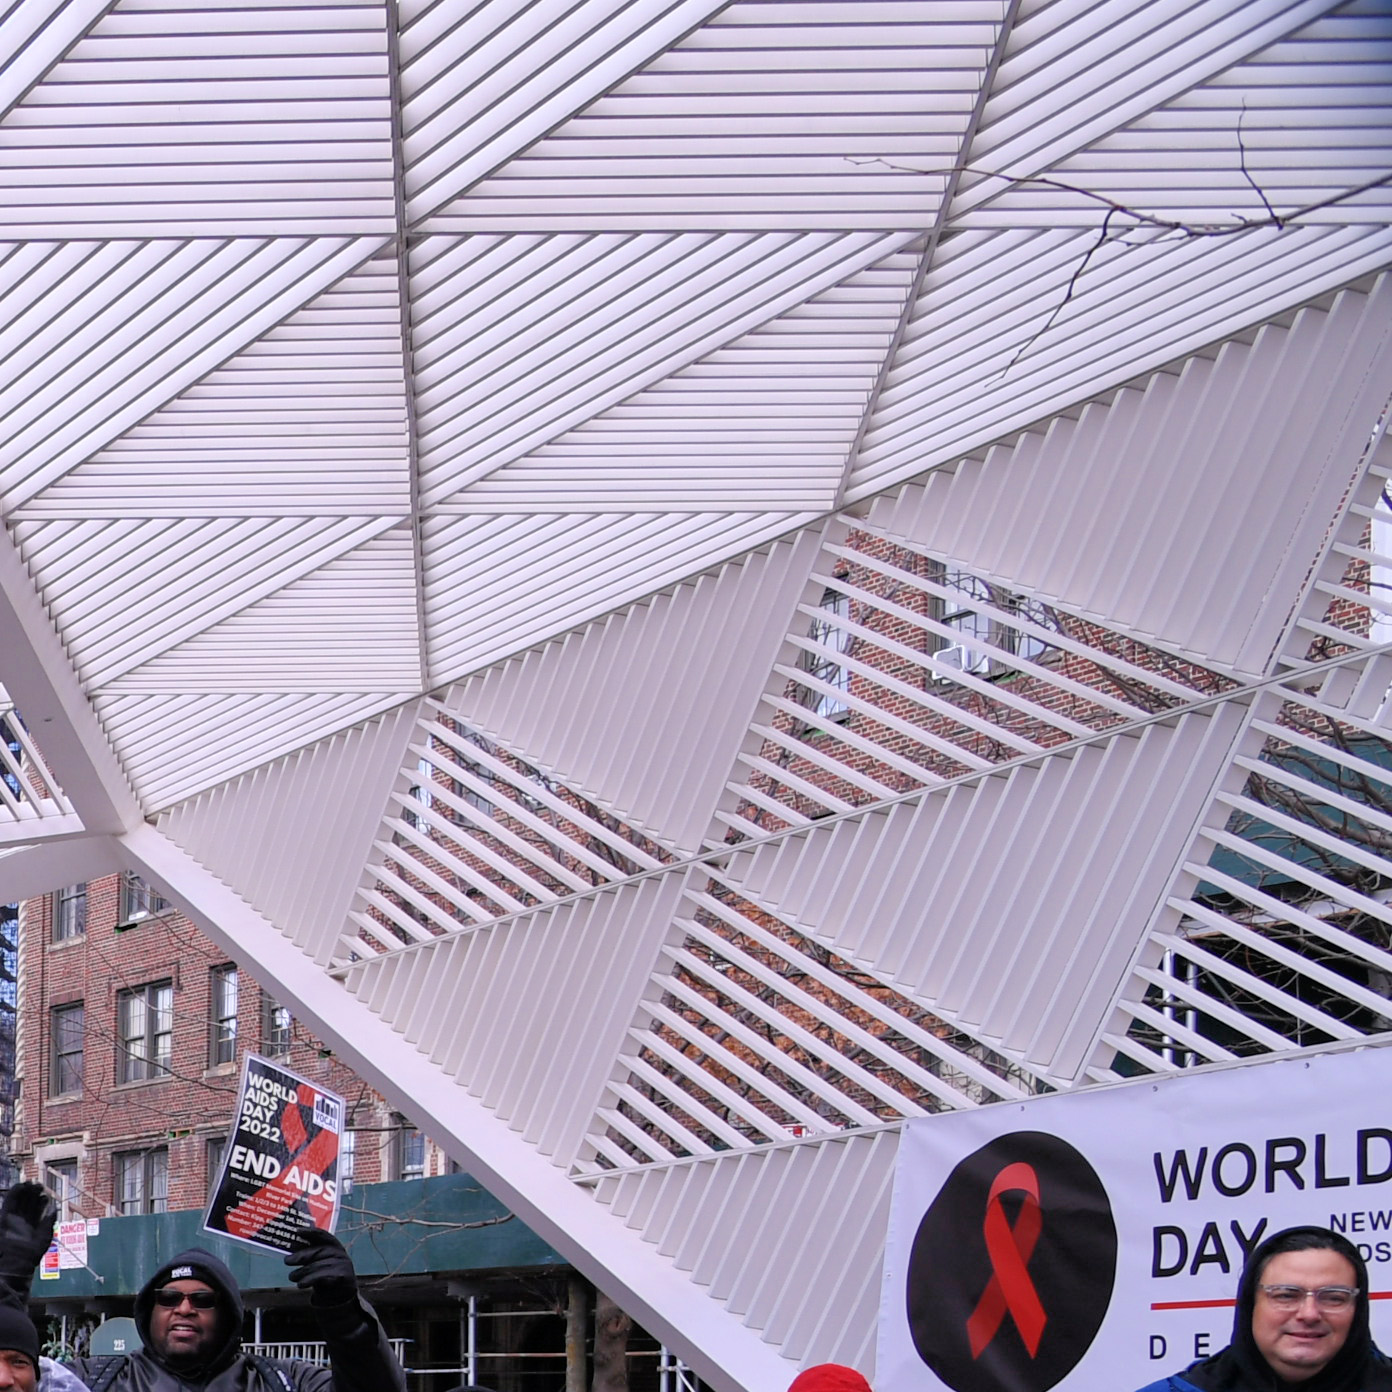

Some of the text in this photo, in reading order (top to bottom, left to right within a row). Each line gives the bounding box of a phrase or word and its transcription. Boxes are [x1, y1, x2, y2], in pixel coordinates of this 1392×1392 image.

[245, 1087, 278, 1111] AIDS
[248, 1071, 298, 1104] WORLD
[243, 1102, 275, 1123] DAY
[315, 1111, 338, 1129] VOCAL
[239, 1117, 281, 1143] 2022
[229, 1145, 336, 1202] END AIDS
[1153, 1127, 1392, 1203] WORLD
[249, 1178, 265, 1188] LGBT
[256, 1205, 285, 1220] December
[1330, 1210, 1392, 1233] NEW
[1151, 1217, 1268, 1278] DAY
